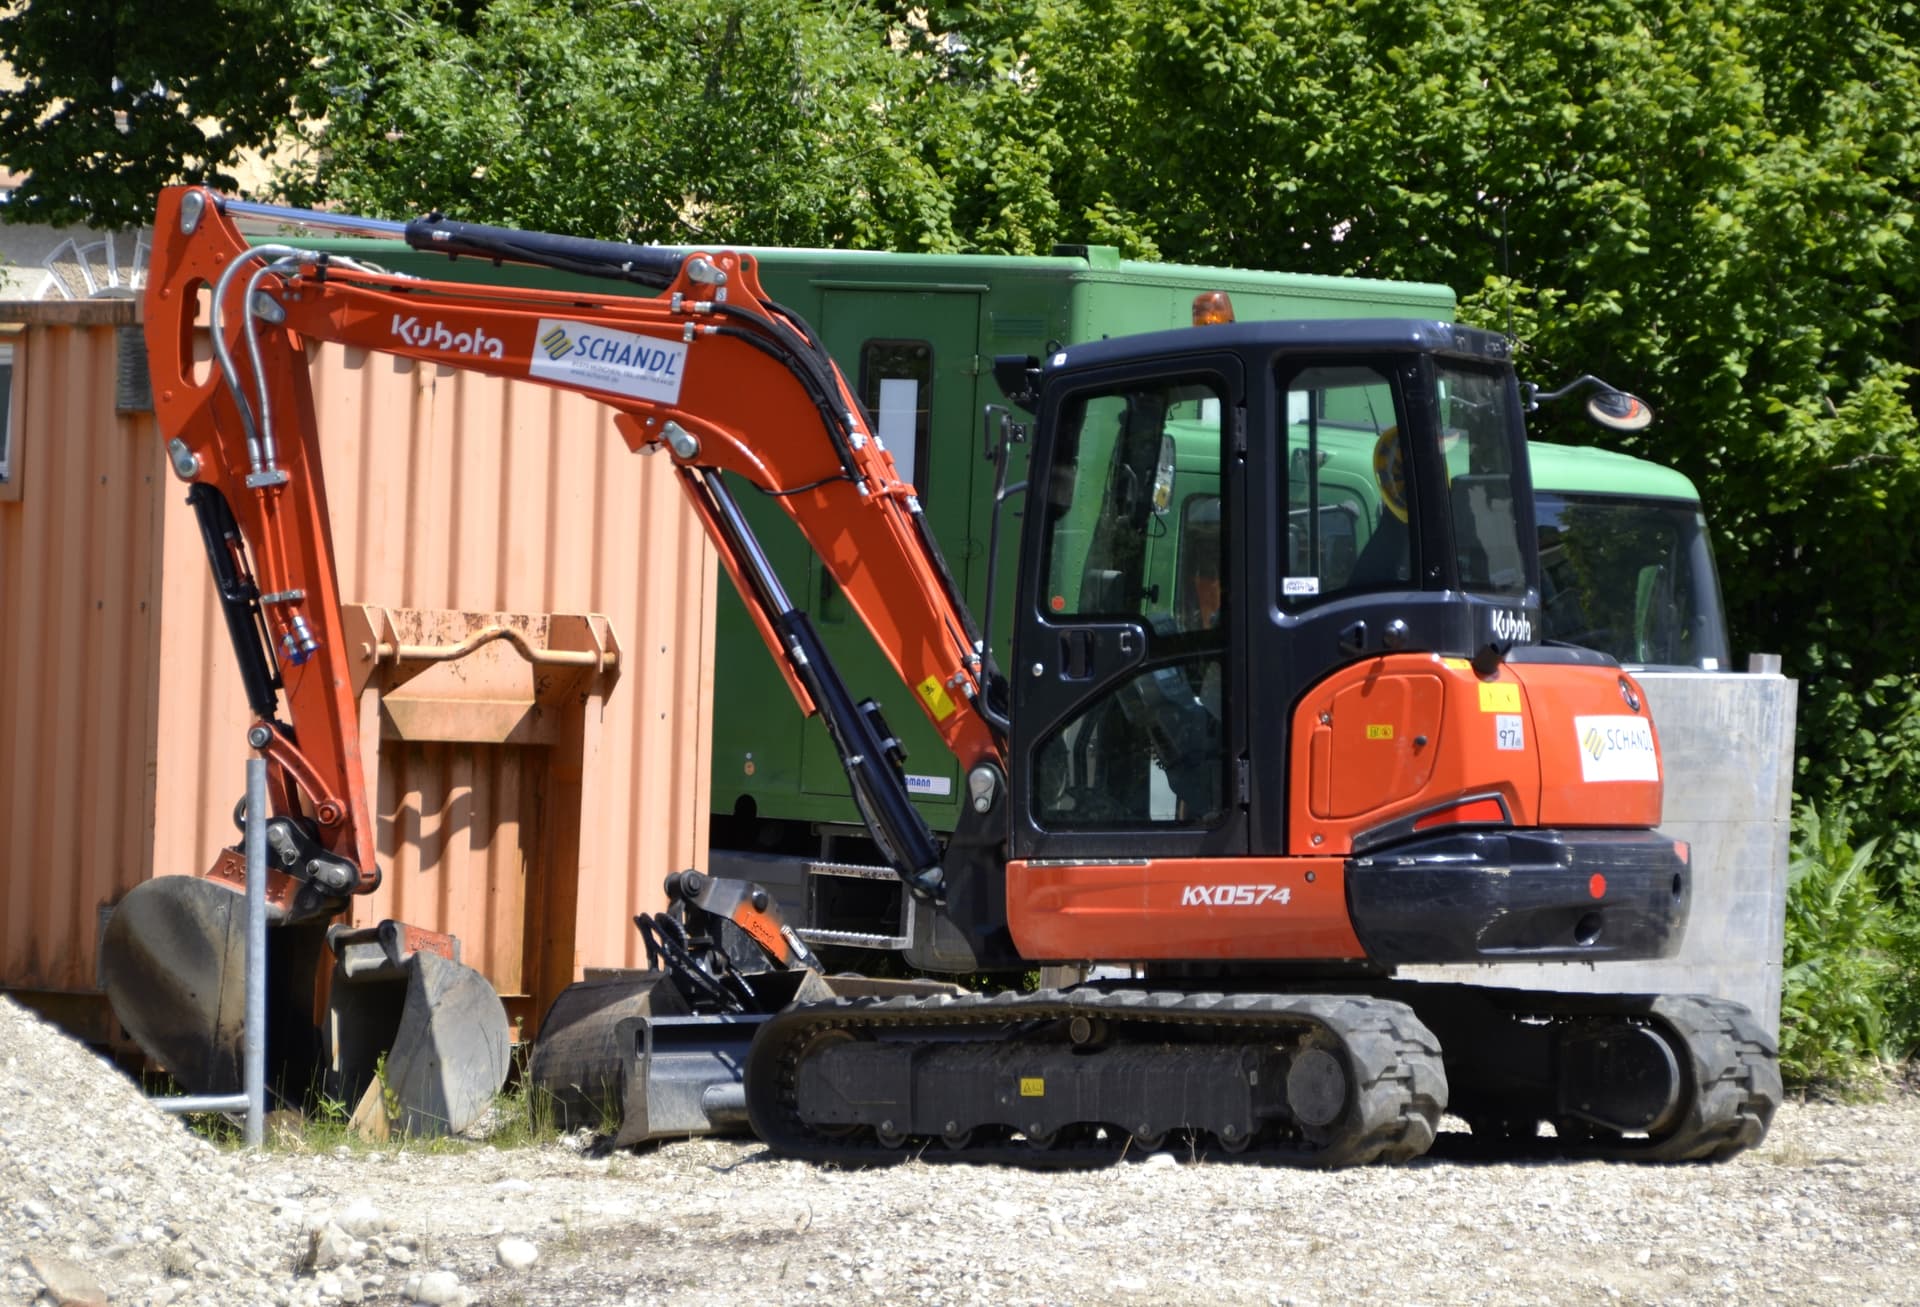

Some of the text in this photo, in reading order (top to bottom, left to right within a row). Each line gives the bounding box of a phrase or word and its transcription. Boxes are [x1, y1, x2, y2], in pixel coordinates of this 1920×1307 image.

[391, 314, 504, 359] Kubota
[575, 335, 677, 375] SCHANDL
[1493, 610, 1531, 641] Kubota
[1499, 729, 1516, 747] 97
